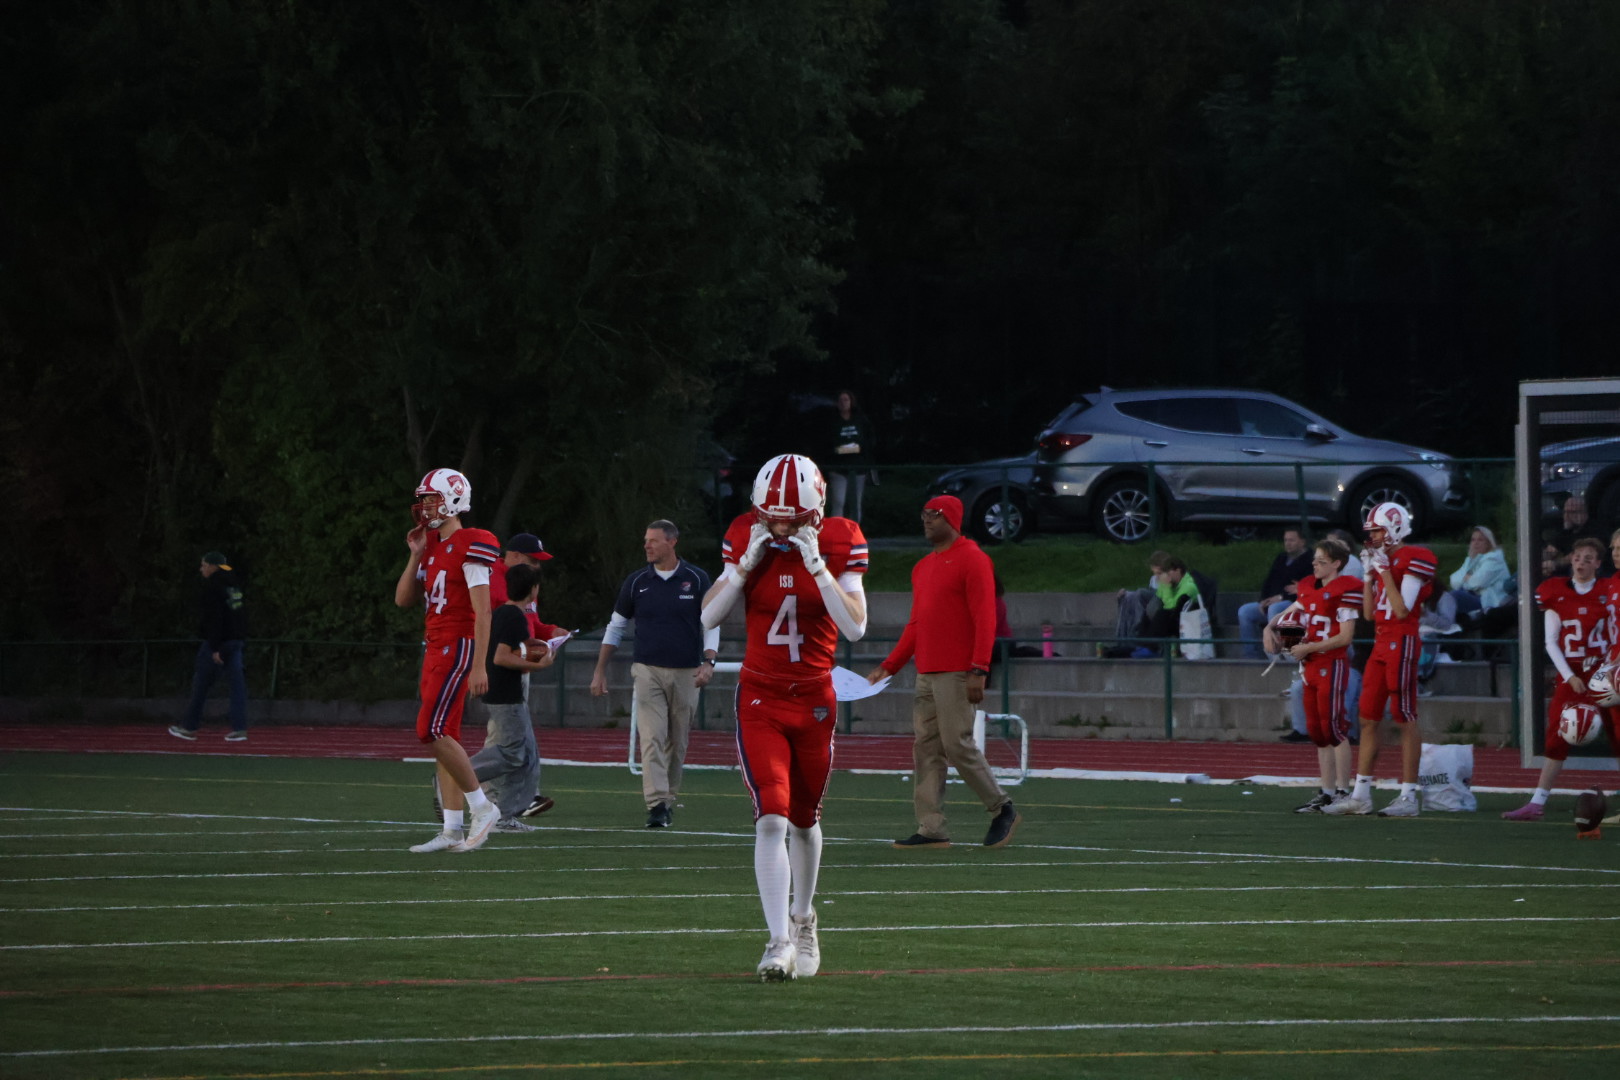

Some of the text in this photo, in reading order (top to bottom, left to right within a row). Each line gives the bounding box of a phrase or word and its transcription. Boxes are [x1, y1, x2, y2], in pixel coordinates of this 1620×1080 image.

[779, 575, 794, 588] ISB
[767, 594, 805, 663] 4
[1562, 617, 1608, 658] 24
